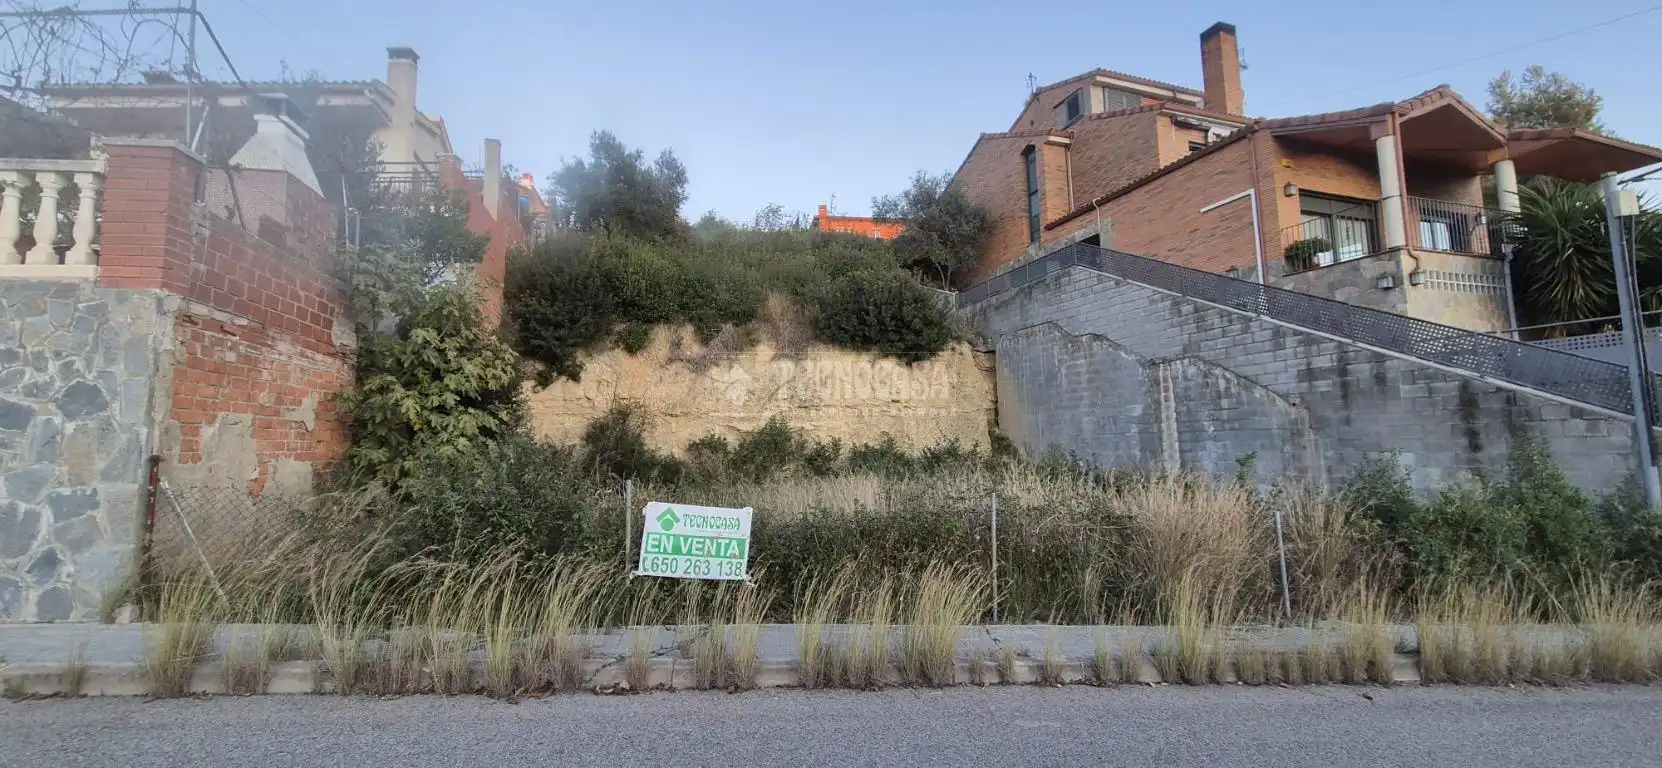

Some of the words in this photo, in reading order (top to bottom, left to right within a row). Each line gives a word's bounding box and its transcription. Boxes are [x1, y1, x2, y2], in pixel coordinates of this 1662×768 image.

[682, 513, 741, 531] TECNOCASA
[647, 534, 673, 553] EN
[680, 536, 740, 557] VENTA
[651, 556, 679, 573] 650
[683, 558, 711, 576] 263
[717, 561, 743, 577] 138
